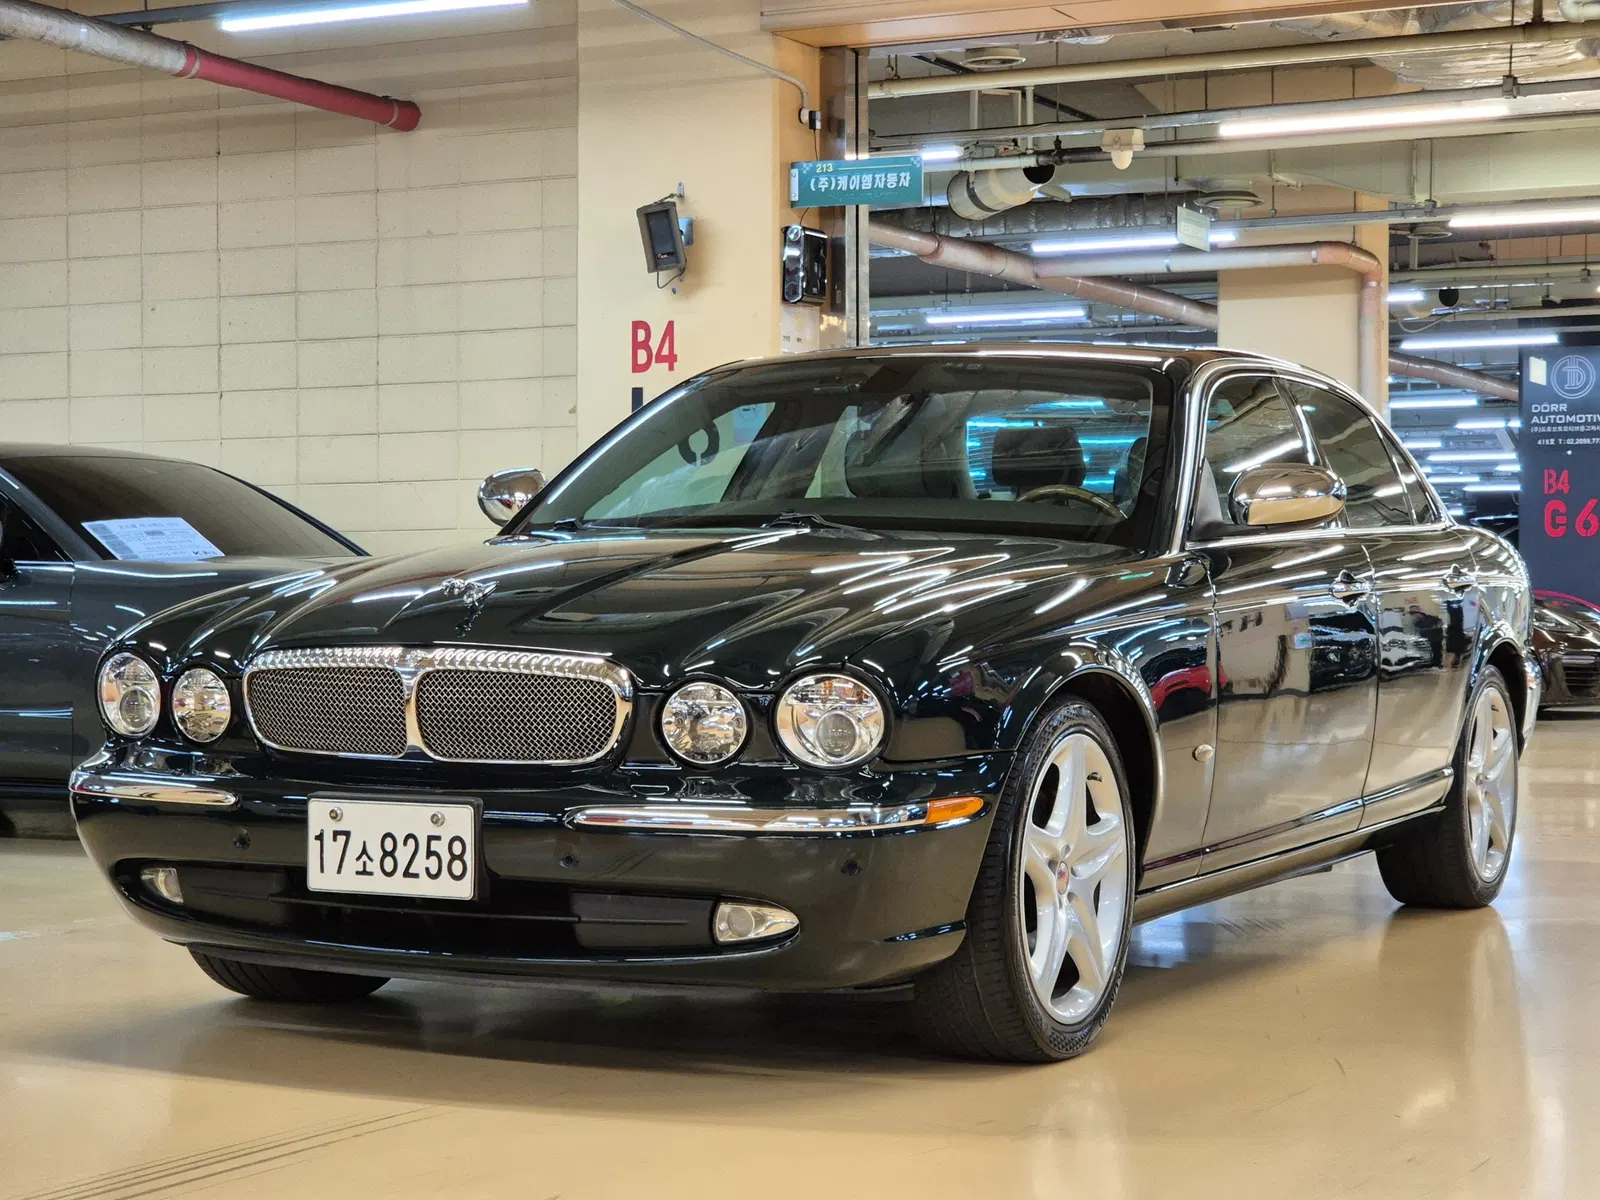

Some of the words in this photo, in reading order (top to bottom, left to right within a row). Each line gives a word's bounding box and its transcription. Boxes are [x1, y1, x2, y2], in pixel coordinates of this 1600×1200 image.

[810, 171, 911, 192] (주)케이엠자동차
[815, 163, 834, 173] 213
[631, 320, 678, 373] B4
[1544, 468, 1570, 495] B4
[314, 828, 469, 882] 17소8258
